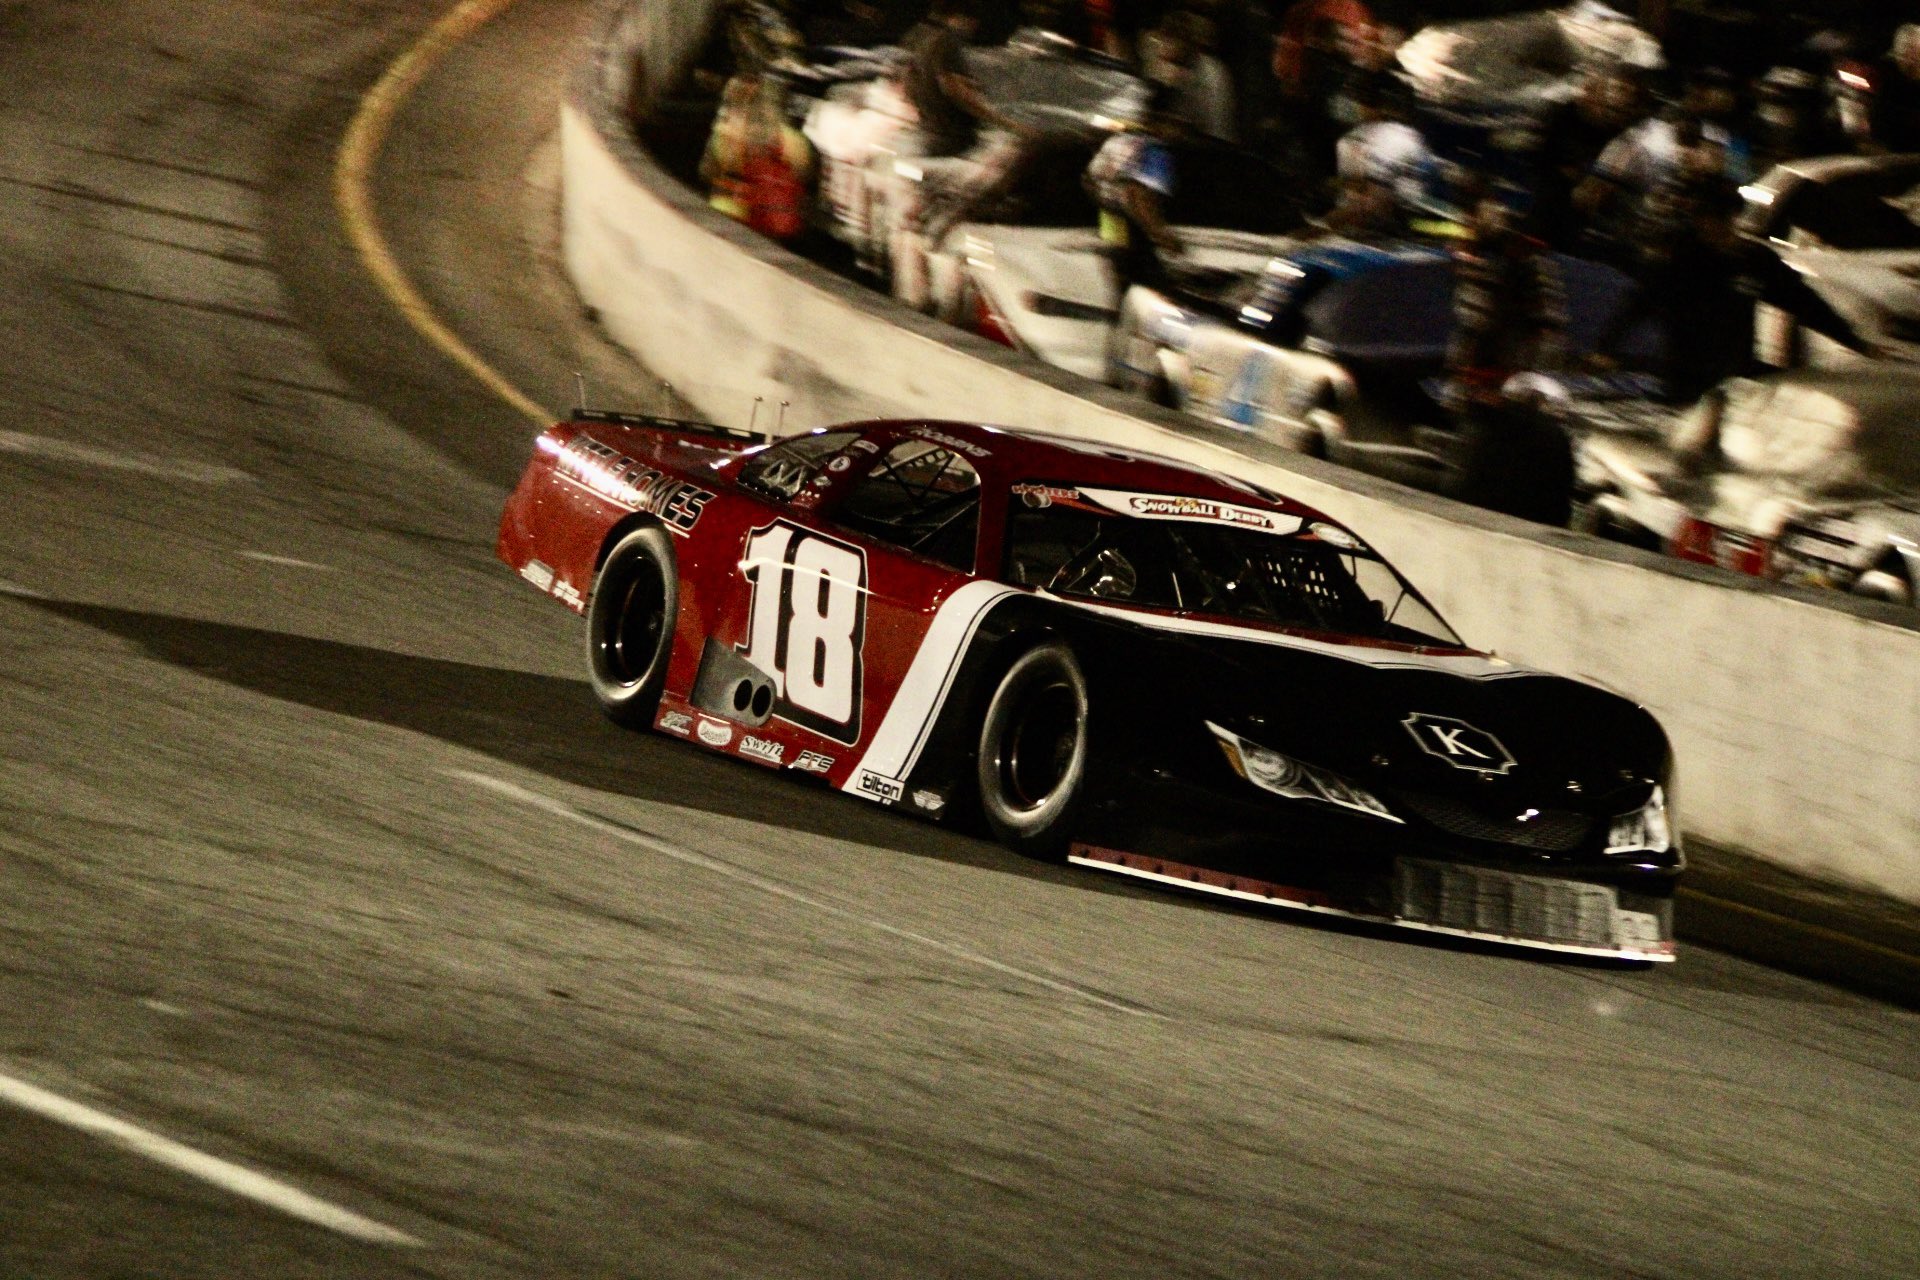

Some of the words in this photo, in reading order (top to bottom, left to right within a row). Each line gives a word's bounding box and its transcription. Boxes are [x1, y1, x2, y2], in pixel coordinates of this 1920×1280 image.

[740, 522, 864, 726] 18
[1426, 725, 1494, 759] K
[863, 774, 900, 799] tilton
